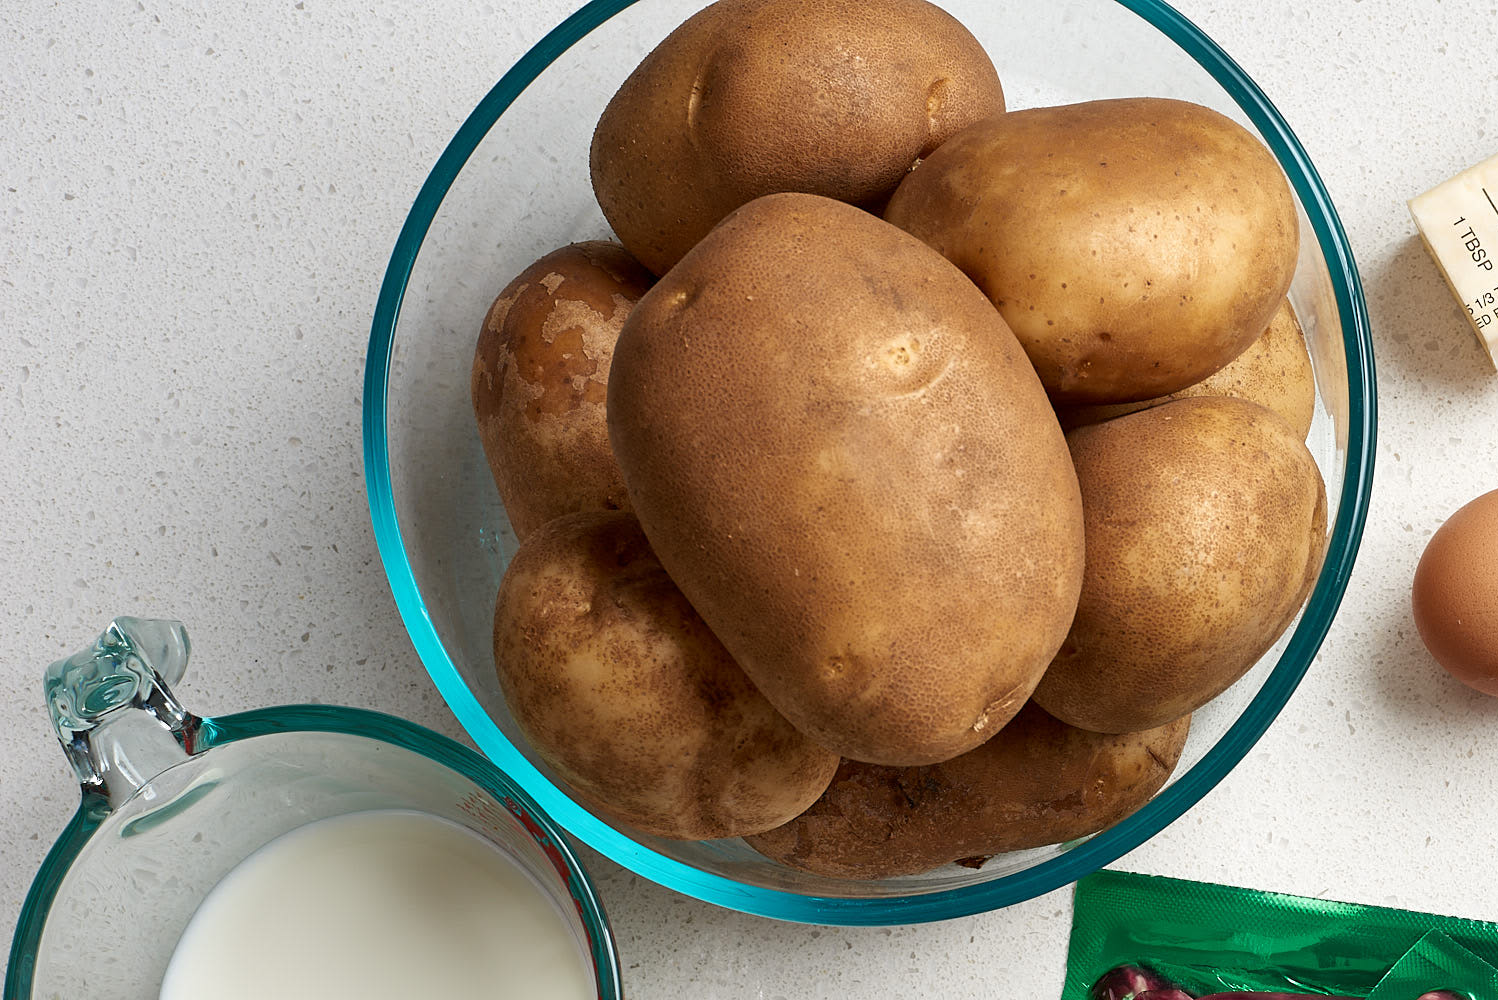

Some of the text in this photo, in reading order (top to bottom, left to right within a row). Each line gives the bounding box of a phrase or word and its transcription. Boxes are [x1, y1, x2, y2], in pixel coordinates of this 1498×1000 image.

[1453, 216, 1493, 272] 1 TBSP
[1474, 292, 1495, 310] 1/3
